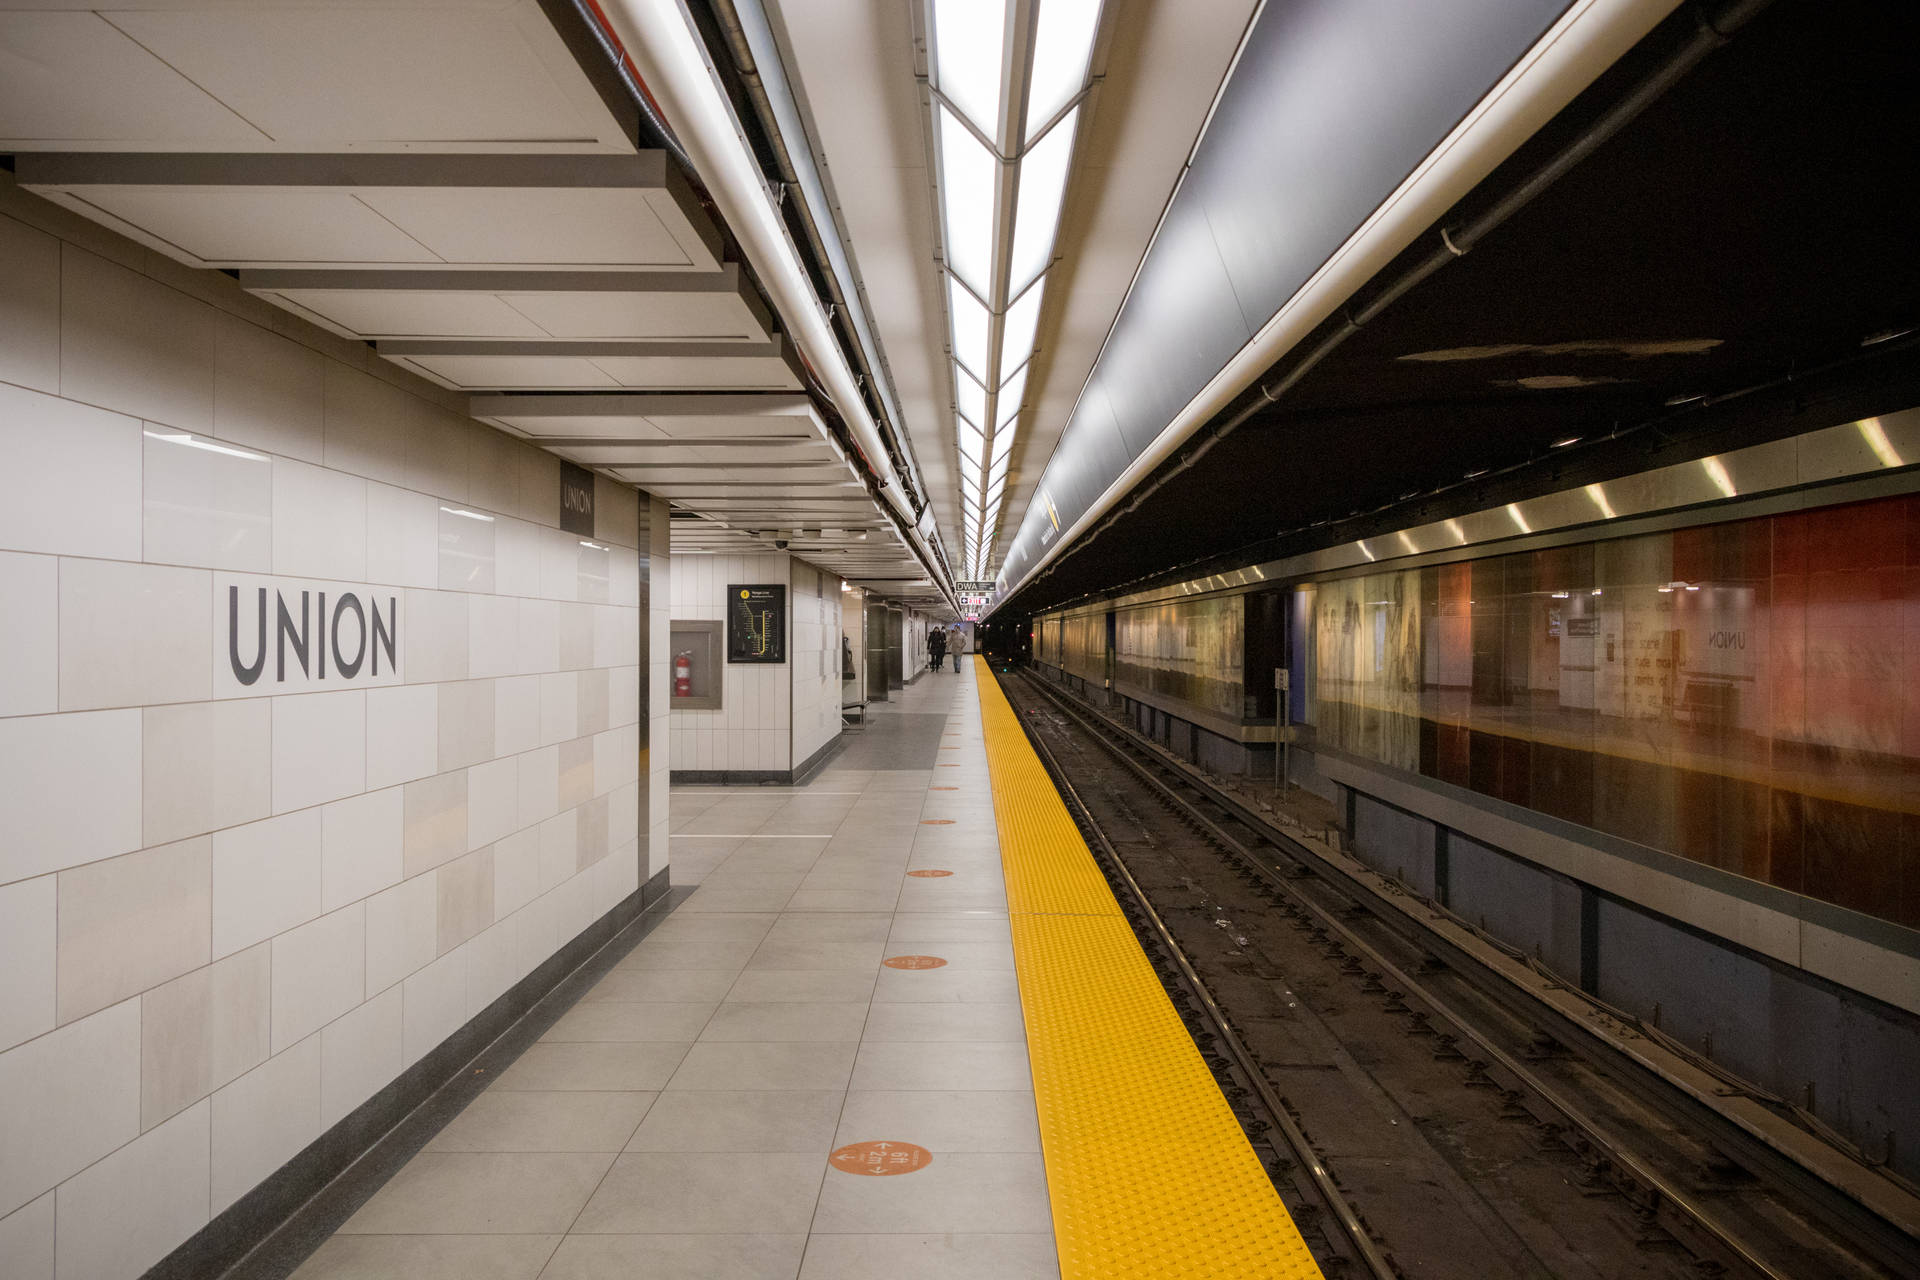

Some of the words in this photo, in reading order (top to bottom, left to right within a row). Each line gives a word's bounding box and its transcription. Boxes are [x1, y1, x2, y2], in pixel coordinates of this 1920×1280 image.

[564, 483, 592, 513] UNION
[957, 582, 978, 591] DWA
[229, 585, 396, 686] UNION
